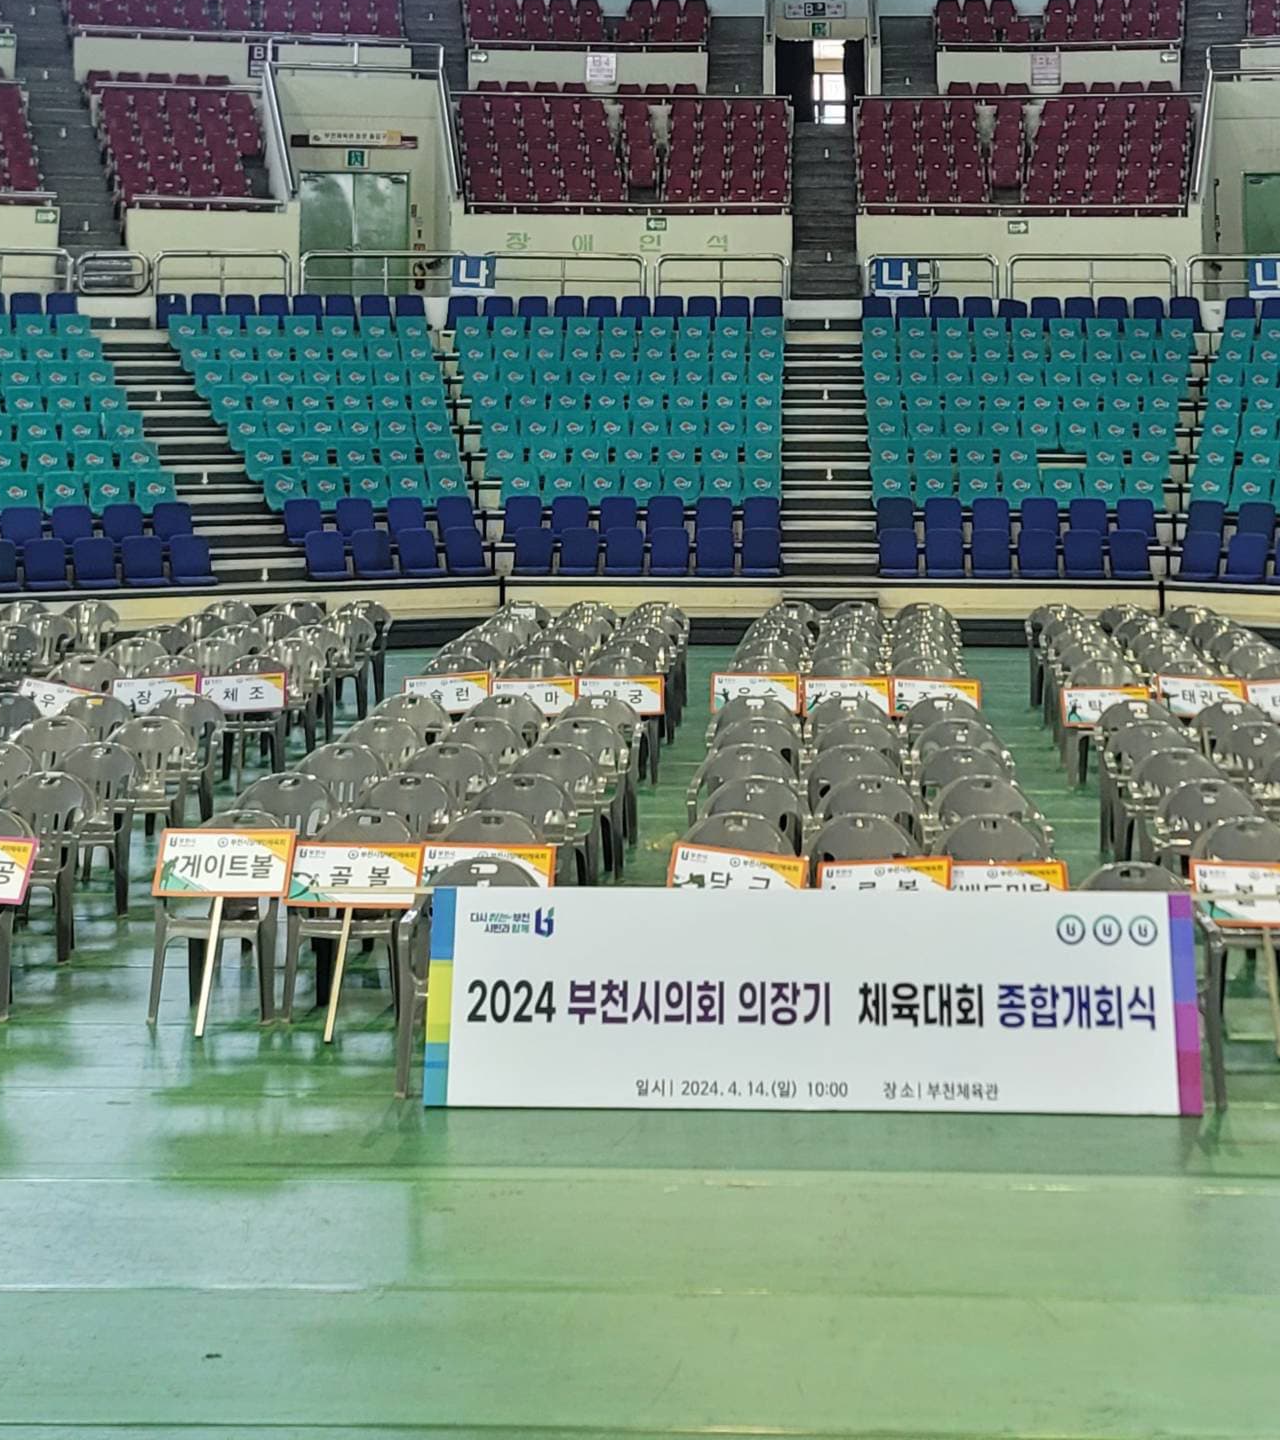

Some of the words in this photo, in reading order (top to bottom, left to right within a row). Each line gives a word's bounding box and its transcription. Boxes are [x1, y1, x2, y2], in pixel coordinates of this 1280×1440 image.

[459, 258, 489, 288] 나
[882, 261, 912, 289] 나
[179, 853, 274, 880] 게이트볼
[466, 979, 557, 1023] 2024
[568, 979, 725, 1025] 부천시의회
[737, 980, 831, 1027] 의장기
[858, 982, 985, 1027] 체육대회
[997, 983, 1157, 1030] 종합개회식
[807, 1081, 848, 1098] 10:00
[926, 1082, 999, 1102] 부천체육관
